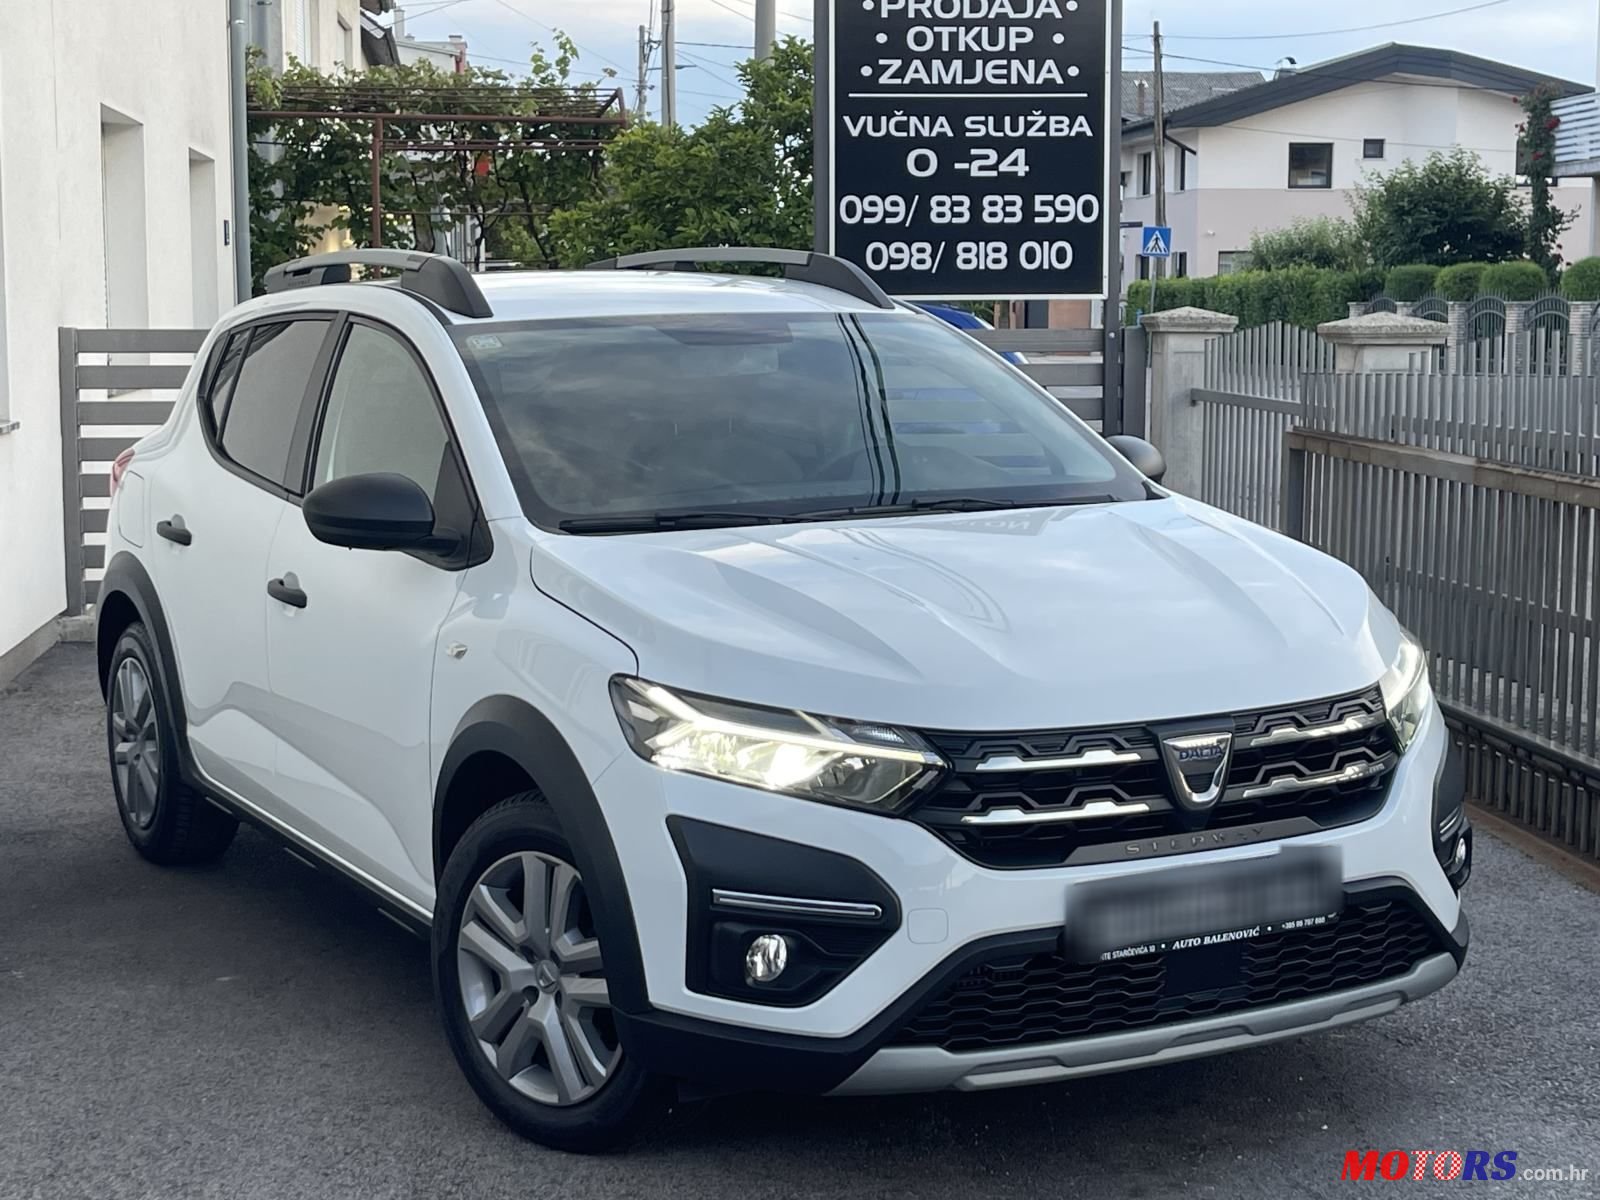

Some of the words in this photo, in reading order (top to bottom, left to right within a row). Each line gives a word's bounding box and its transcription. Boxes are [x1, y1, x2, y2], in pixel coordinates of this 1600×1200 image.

[880, 0, 1063, 19] PRODAJA
[906, 26, 1034, 52] OTKUP
[878, 59, 1064, 85] ZAMJENA
[842, 110, 954, 137] VUČNA
[964, 110, 1094, 137] SLUŽBA
[953, 148, 1030, 177] -24
[839, 194, 920, 227] 099/
[929, 195, 971, 224] 83
[982, 195, 1023, 224] 83
[1034, 194, 1100, 224] 590
[865, 242, 946, 273] 098/
[956, 241, 1008, 270] 818
[1019, 240, 1073, 270] 010
[1179, 744, 1224, 761] DACIA
[1172, 937, 1201, 950] AUTO
[1203, 925, 1260, 945] BALENOVIĆ
